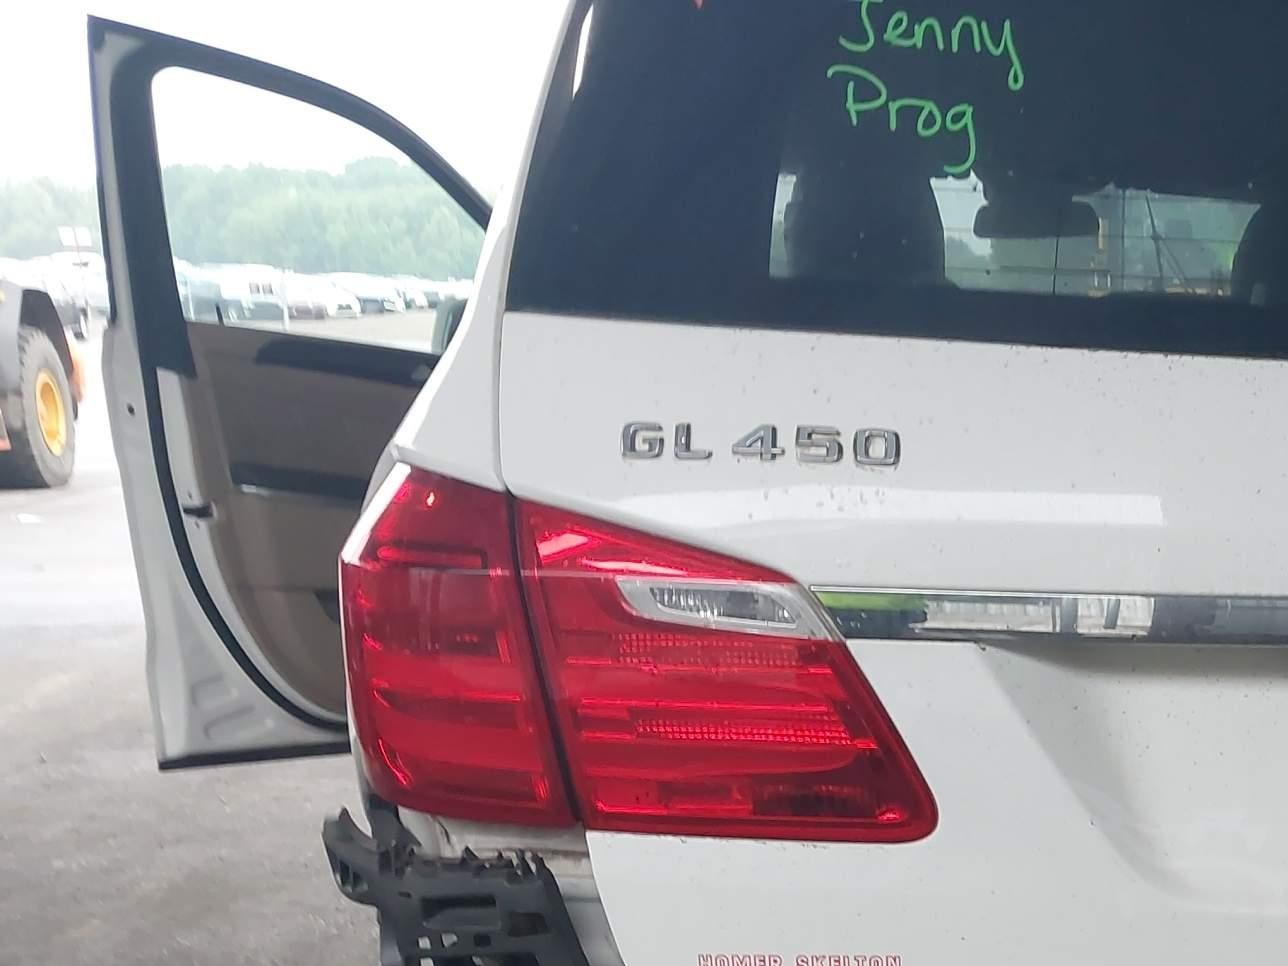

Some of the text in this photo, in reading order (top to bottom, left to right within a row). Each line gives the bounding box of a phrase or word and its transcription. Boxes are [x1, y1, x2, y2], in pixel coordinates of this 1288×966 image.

[838, 0, 1024, 91] Jenny
[826, 64, 976, 173] Prog
[620, 421, 902, 467] GL 450
